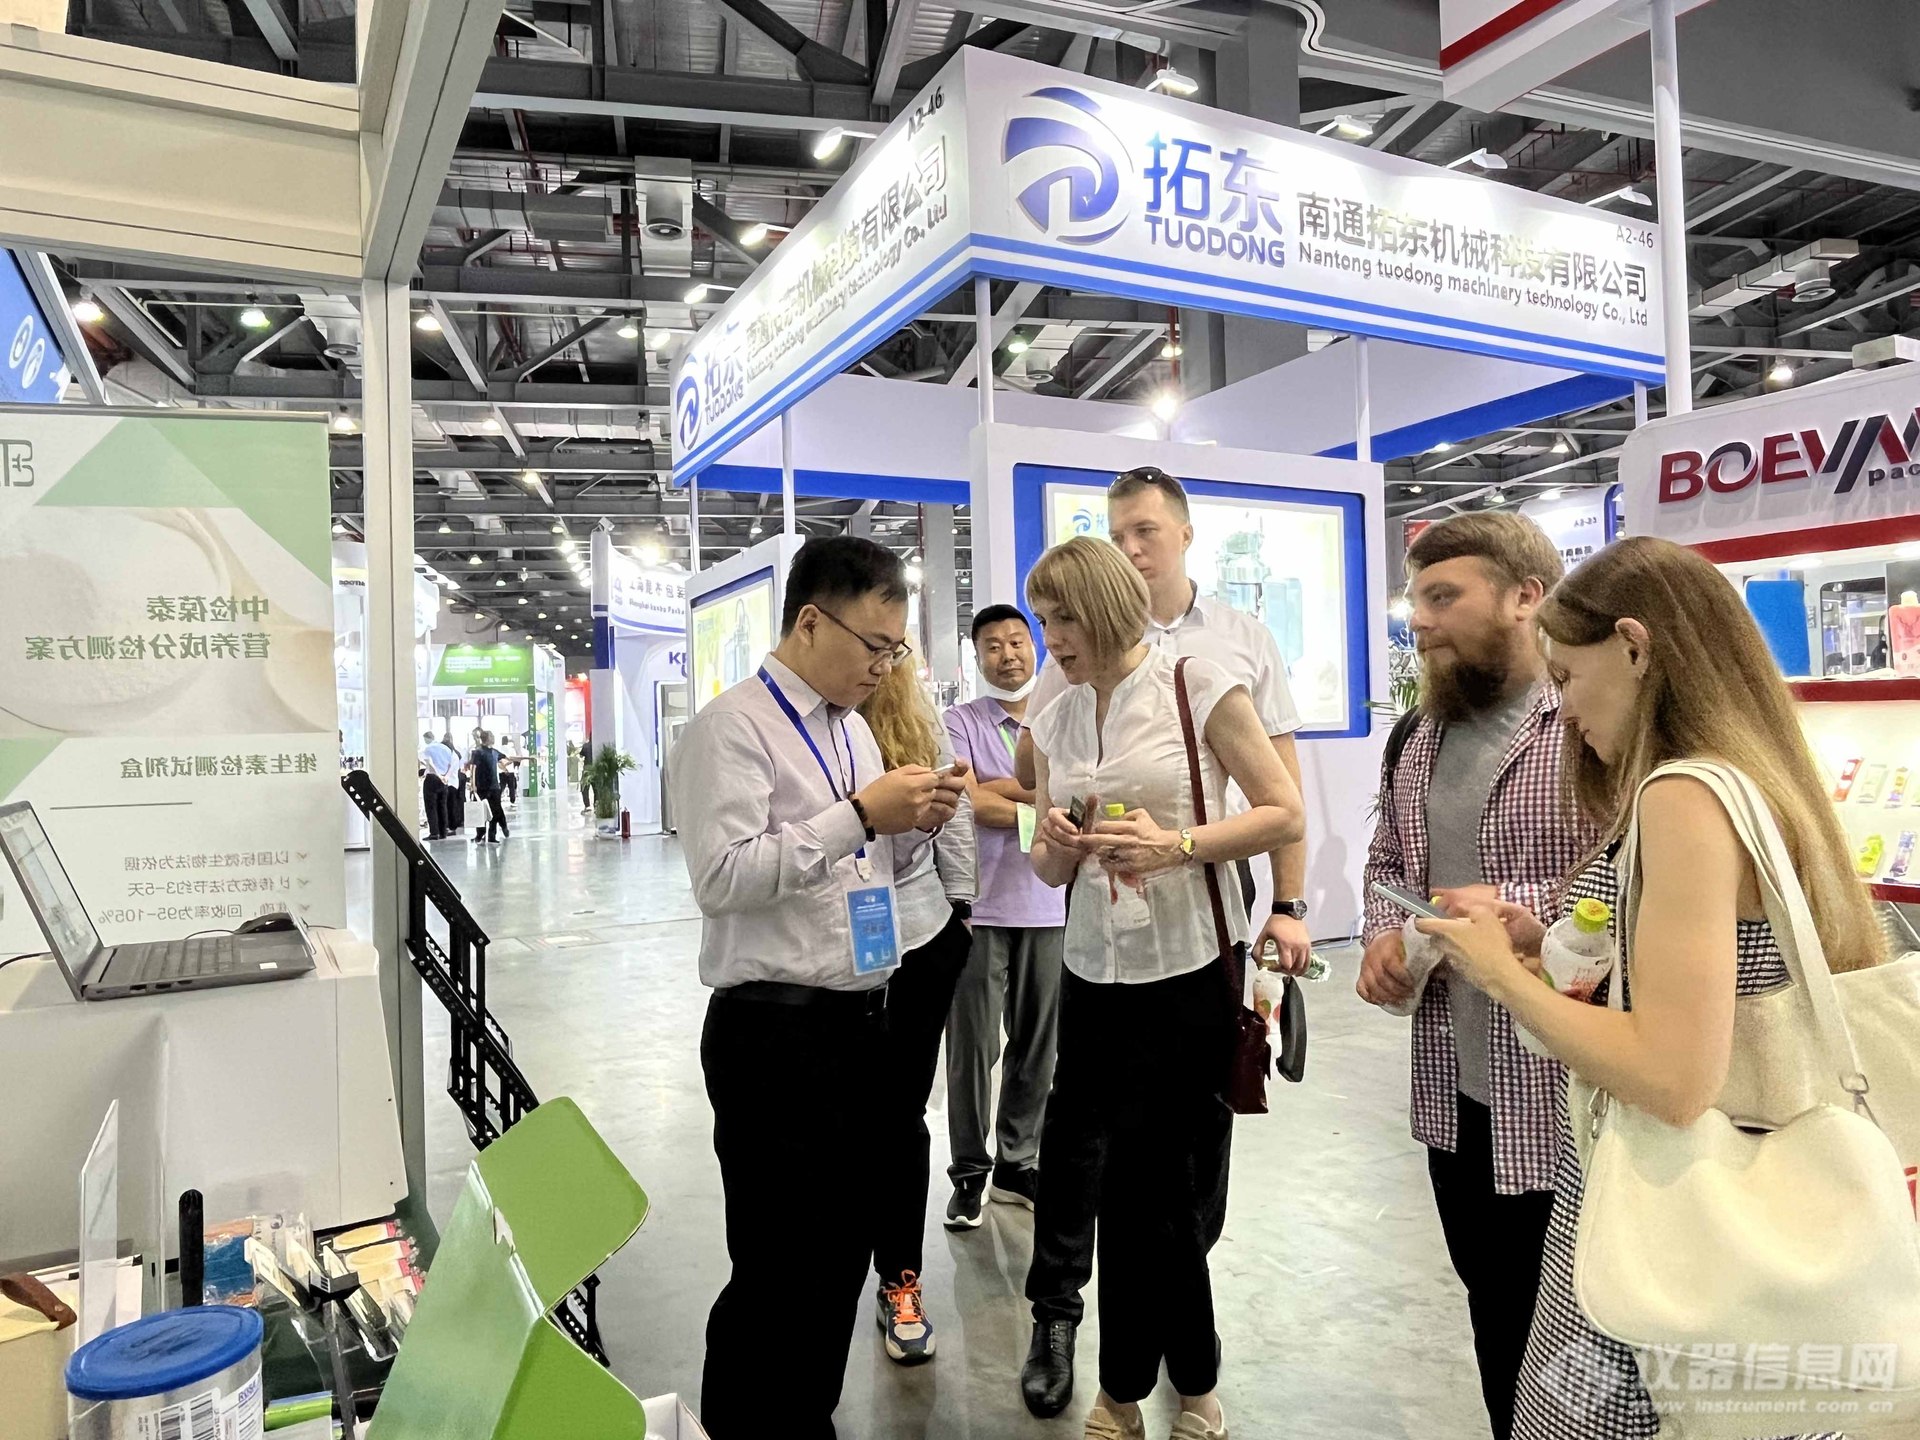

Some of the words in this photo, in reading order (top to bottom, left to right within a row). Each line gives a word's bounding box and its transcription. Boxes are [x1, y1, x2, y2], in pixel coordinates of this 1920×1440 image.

[907, 85, 945, 142] A2-46
[1143, 131, 1284, 236] 拓东
[1144, 214, 1286, 268] TUODONG
[1296, 191, 1647, 303] 南通拓东机械科技有限公司
[1616, 225, 1655, 249] A2-46
[1299, 242, 1372, 280] Nantong
[1377, 258, 1443, 293] tuodong
[1448, 273, 1522, 308] machinery
[1525, 287, 1599, 321] technology
[1602, 302, 1626, 325] Co.,
[1629, 308, 1648, 326] Ltd
